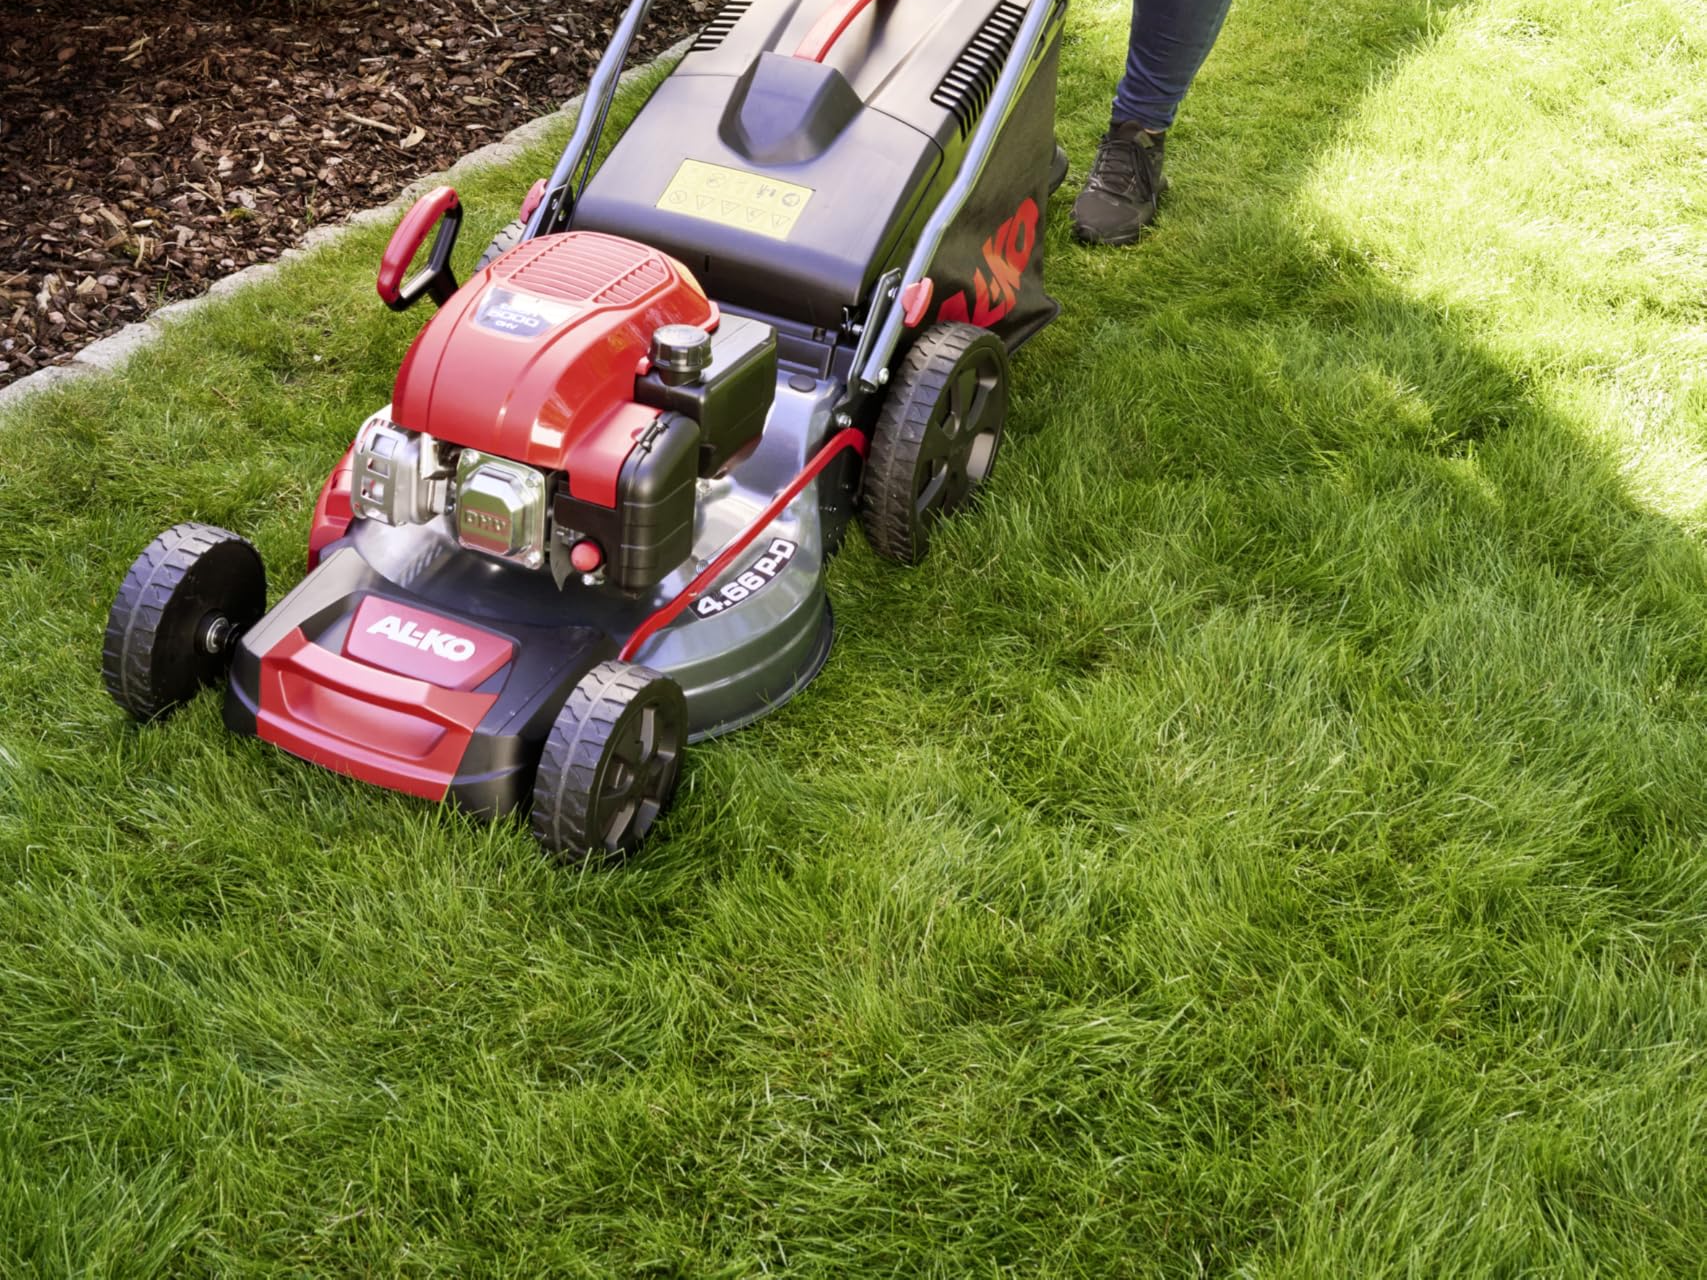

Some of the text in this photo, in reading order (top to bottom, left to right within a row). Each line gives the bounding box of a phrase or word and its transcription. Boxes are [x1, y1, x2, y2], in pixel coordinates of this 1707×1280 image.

[697, 539, 796, 615] 4.66 P-D
[366, 615, 476, 662] AL-KO
